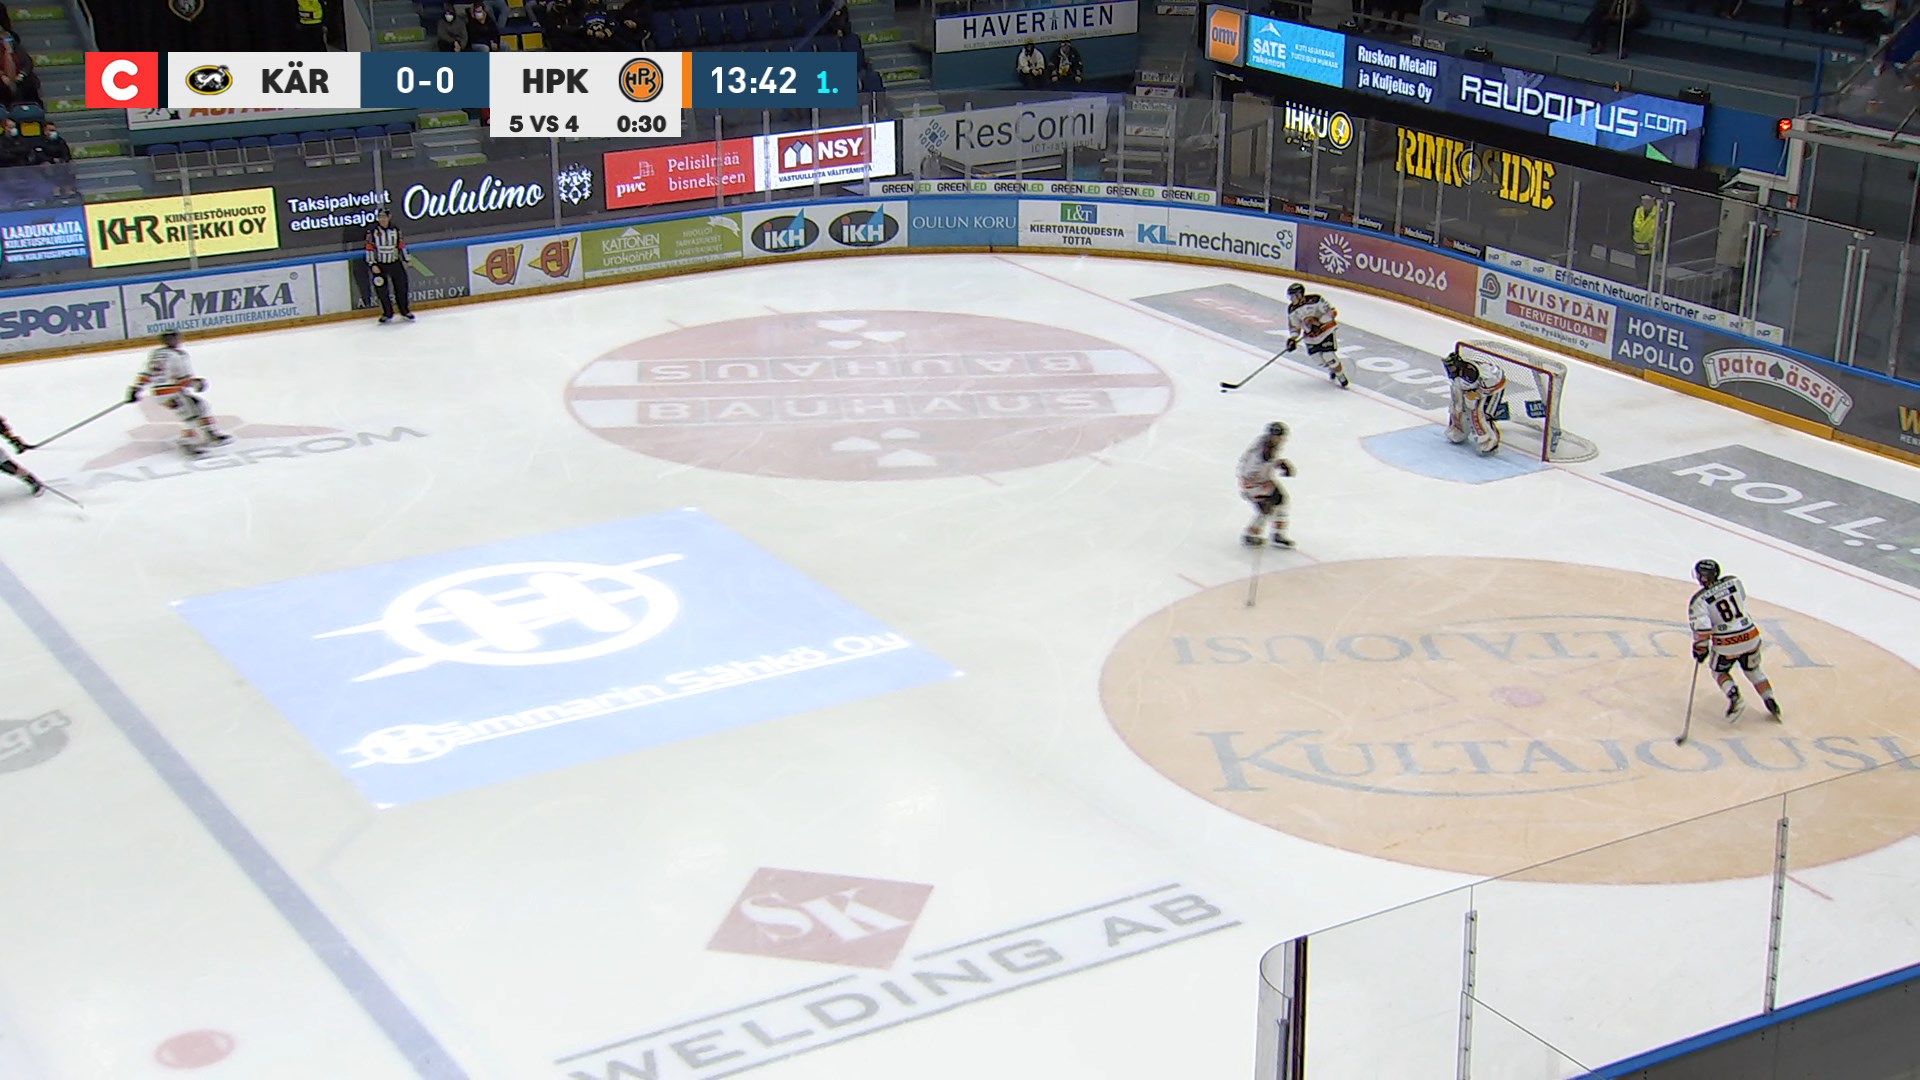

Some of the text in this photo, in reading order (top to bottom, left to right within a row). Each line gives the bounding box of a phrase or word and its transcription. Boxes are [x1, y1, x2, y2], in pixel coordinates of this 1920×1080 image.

[1212, 26, 1237, 46] omv
[1253, 38, 1286, 59] SATE
[1358, 46, 1437, 78] Ruskon Metalli
[1358, 69, 1433, 103] ja Kuljetus Oy
[818, 137, 863, 160] NSY
[402, 175, 546, 220] Oululimo
[616, 181, 646, 198] pwc
[993, 182, 1044, 193] GREENLED
[1050, 184, 1101, 195] GREENLED
[1106, 185, 1155, 198] GREENLED
[1161, 189, 1211, 203] GREENLED
[287, 190, 391, 213] Taksipalvelut
[164, 205, 266, 224] KIINTEISTÖHUOLTO
[912, 216, 1017, 230] OULUN KORU
[1066, 205, 1093, 222] L&T
[2, 220, 83, 240] LAADUKKAITA
[97, 215, 164, 250] KHR
[166, 217, 267, 243] RIEKKI OY
[1030, 224, 1125, 238] KIERTOTALOUDESTA
[1062, 235, 1092, 246] TOTTA
[1137, 223, 1282, 260] KL mechanics
[602, 232, 660, 252] KATTONEN
[1355, 253, 1448, 292] OULU2026
[189, 282, 295, 316] MEKA
[448, 286, 466, 298] OY
[1506, 281, 1610, 326] KIVISYDÄN
[147, 318, 199, 334] KOTIMAISET
[1519, 305, 1593, 337] TERVETULOA!
[1580, 339, 1589, 348] Oy
[1626, 317, 1689, 350] HOTEL
[1618, 340, 1694, 376] APOLLO
[1719, 356, 1836, 409] pata ässä
[648, 392, 1107, 422] BAUHAUS
[1715, 595, 1743, 622] 81
[1725, 632, 1750, 646] SSAB
[668, 640, 830, 694] Sähkö
[833, 630, 912, 662] Oy
[1193, 727, 1920, 795] KULTAJOUSI
[740, 889, 912, 944] SK
[568, 893, 1222, 1080] WELDING AB
